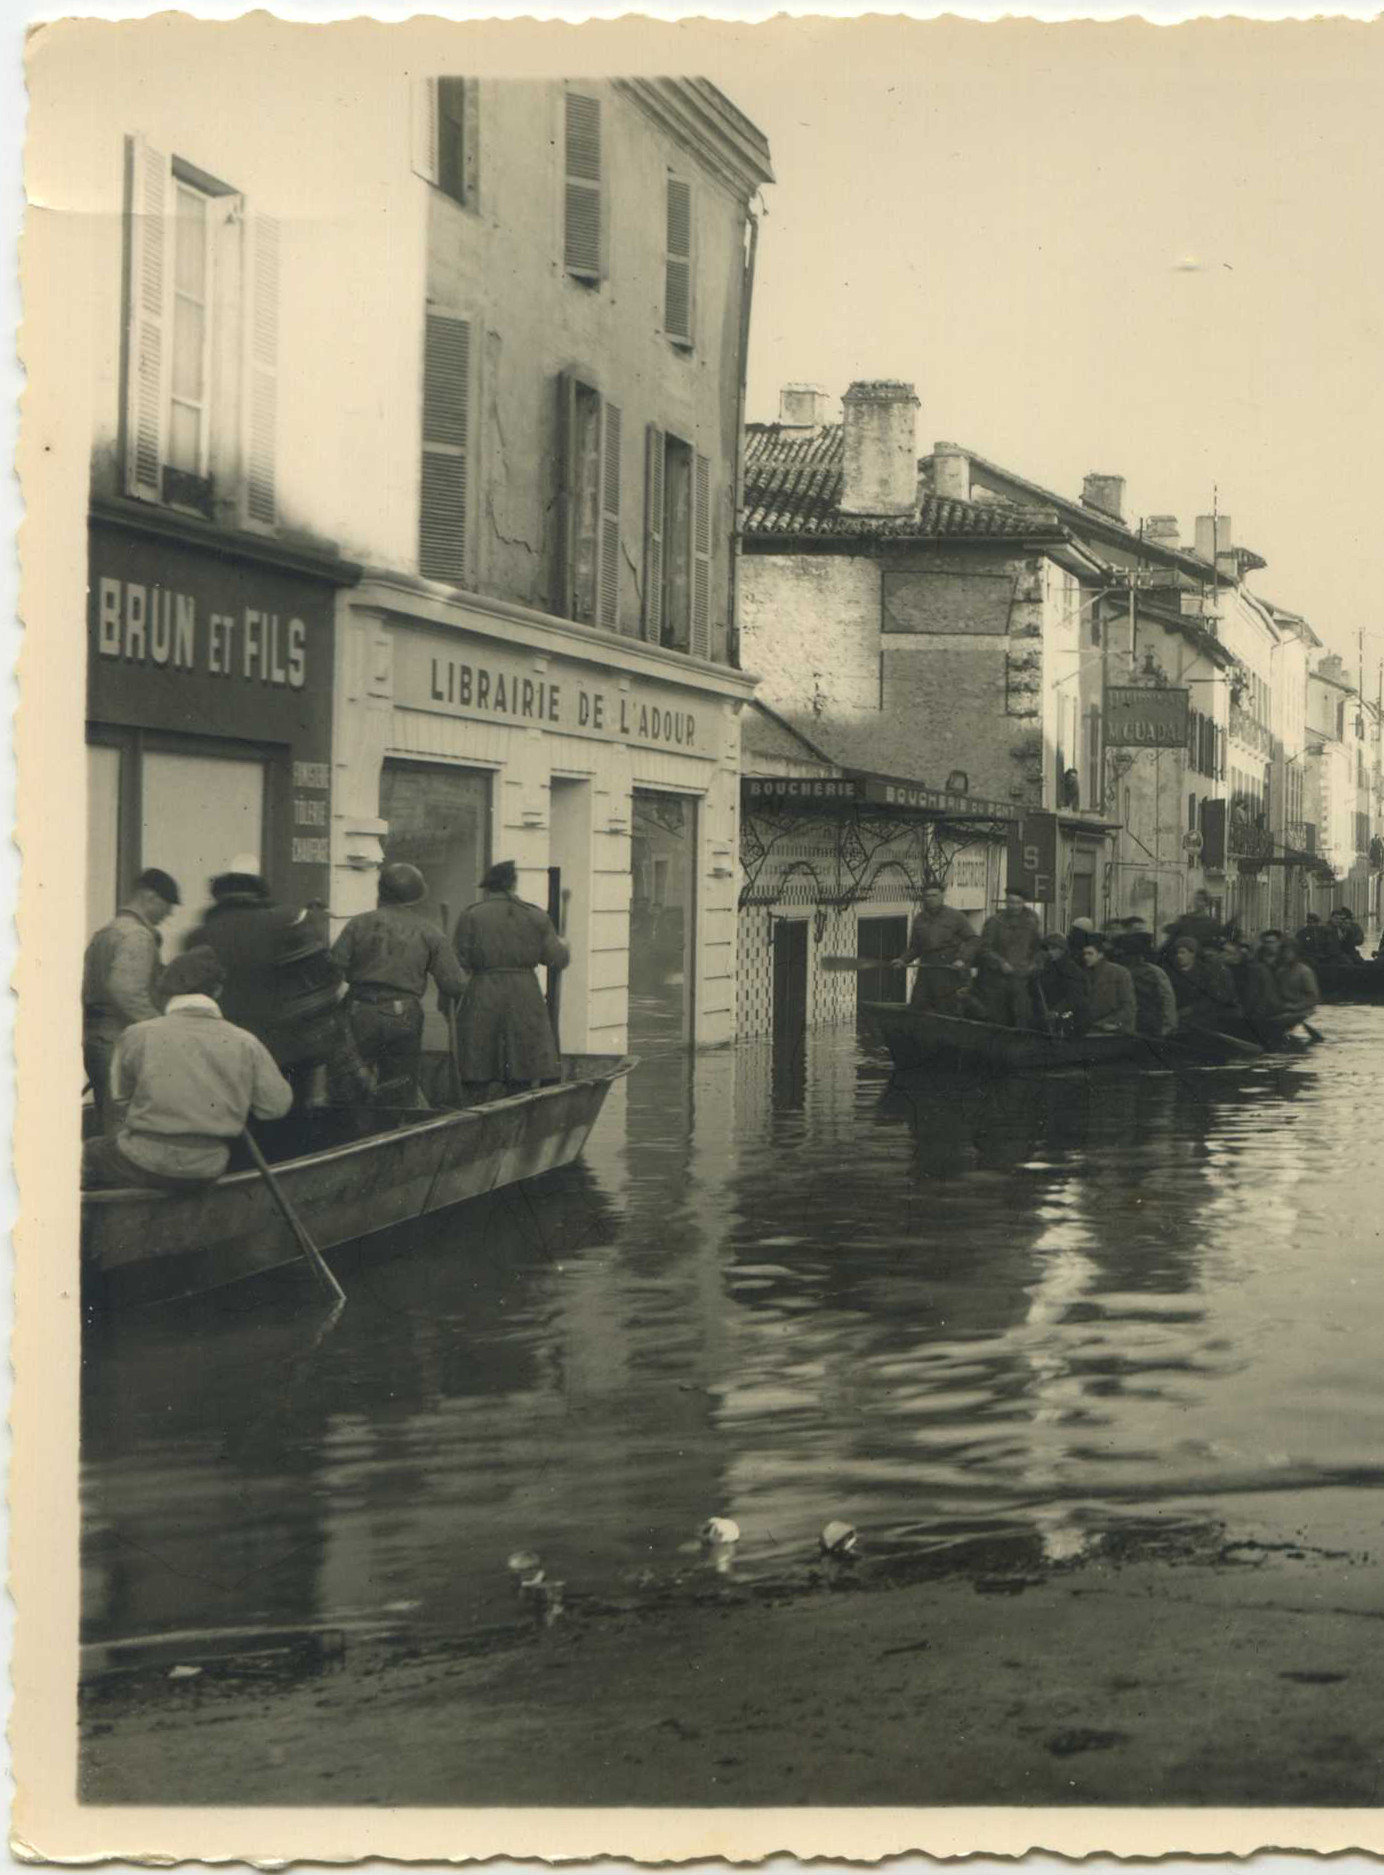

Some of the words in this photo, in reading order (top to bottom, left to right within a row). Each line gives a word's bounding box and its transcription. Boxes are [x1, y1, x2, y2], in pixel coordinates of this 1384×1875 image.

[99, 576, 195, 669] BRUN
[208, 613, 235, 674] ET
[244, 606, 305, 688] FILS
[431, 658, 561, 723] LIBRAIRIE
[577, 691, 604, 729] DE
[619, 699, 695, 747] L'ADOUR
[750, 781, 855, 796] BOUCHERIE
[885, 785, 966, 811] BOUCHERIE
[988, 803, 1015, 817] PONT
